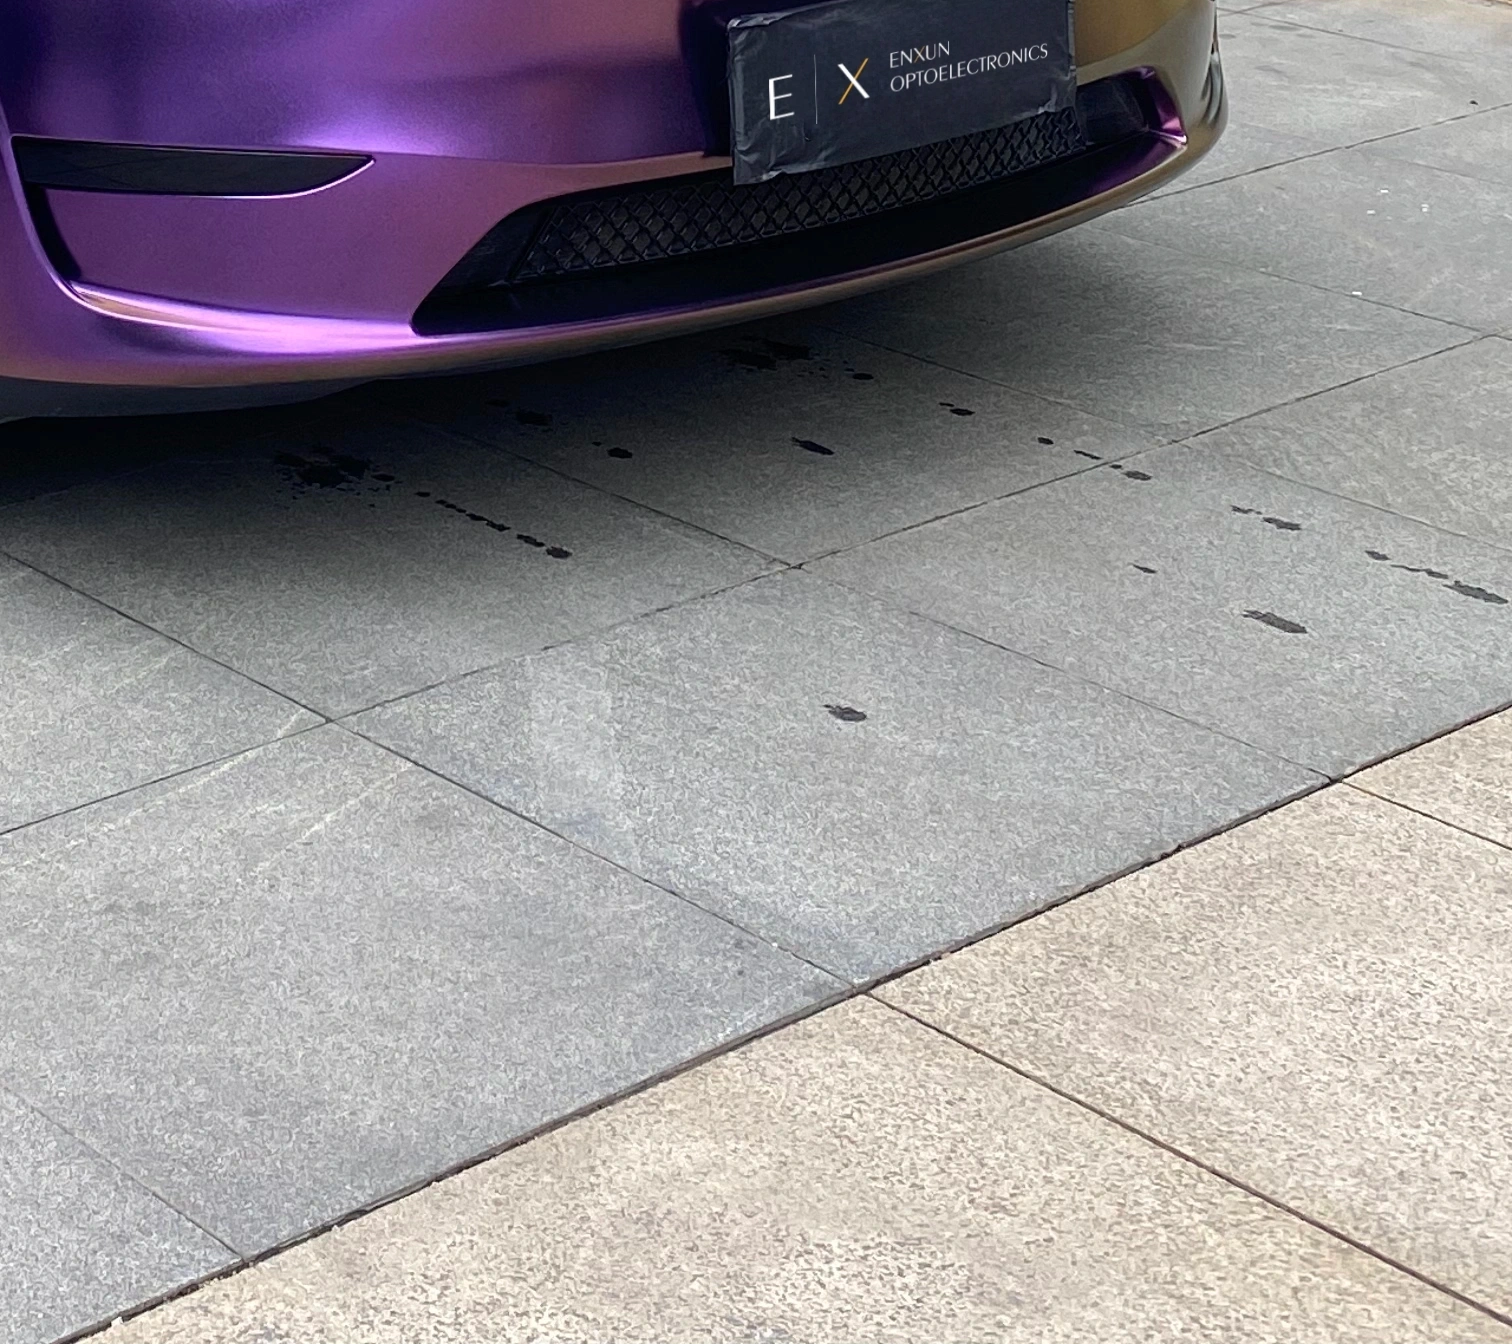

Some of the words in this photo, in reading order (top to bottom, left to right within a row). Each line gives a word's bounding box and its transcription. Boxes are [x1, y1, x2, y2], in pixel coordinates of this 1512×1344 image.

[889, 40, 950, 69] ENXUN
[890, 43, 1048, 92] OPTOELECTRONICS
[768, 73, 795, 121] E
[837, 57, 870, 105] X
